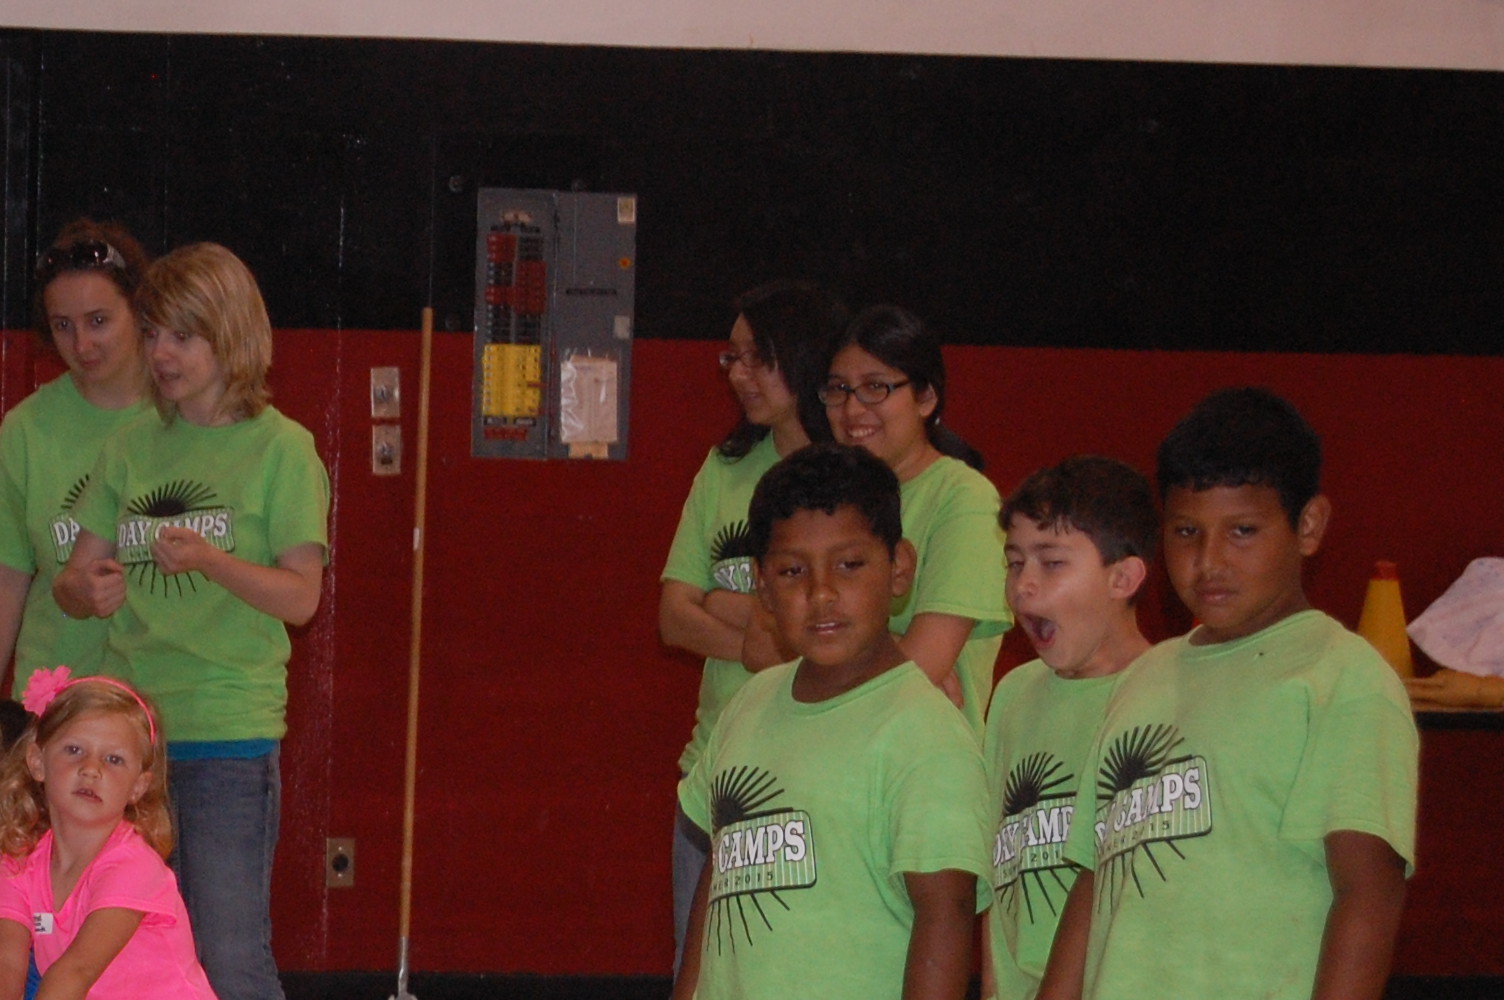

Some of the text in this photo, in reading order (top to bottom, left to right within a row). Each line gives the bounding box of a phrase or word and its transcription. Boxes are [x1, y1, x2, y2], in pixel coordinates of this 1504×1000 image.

[118, 520, 152, 548] DAY
[1113, 767, 1202, 832] CAMPS
[1021, 805, 1074, 848] AMP
[718, 820, 806, 873] CAMPS
[1030, 850, 1060, 863] 201
[735, 871, 774, 886] 2015
